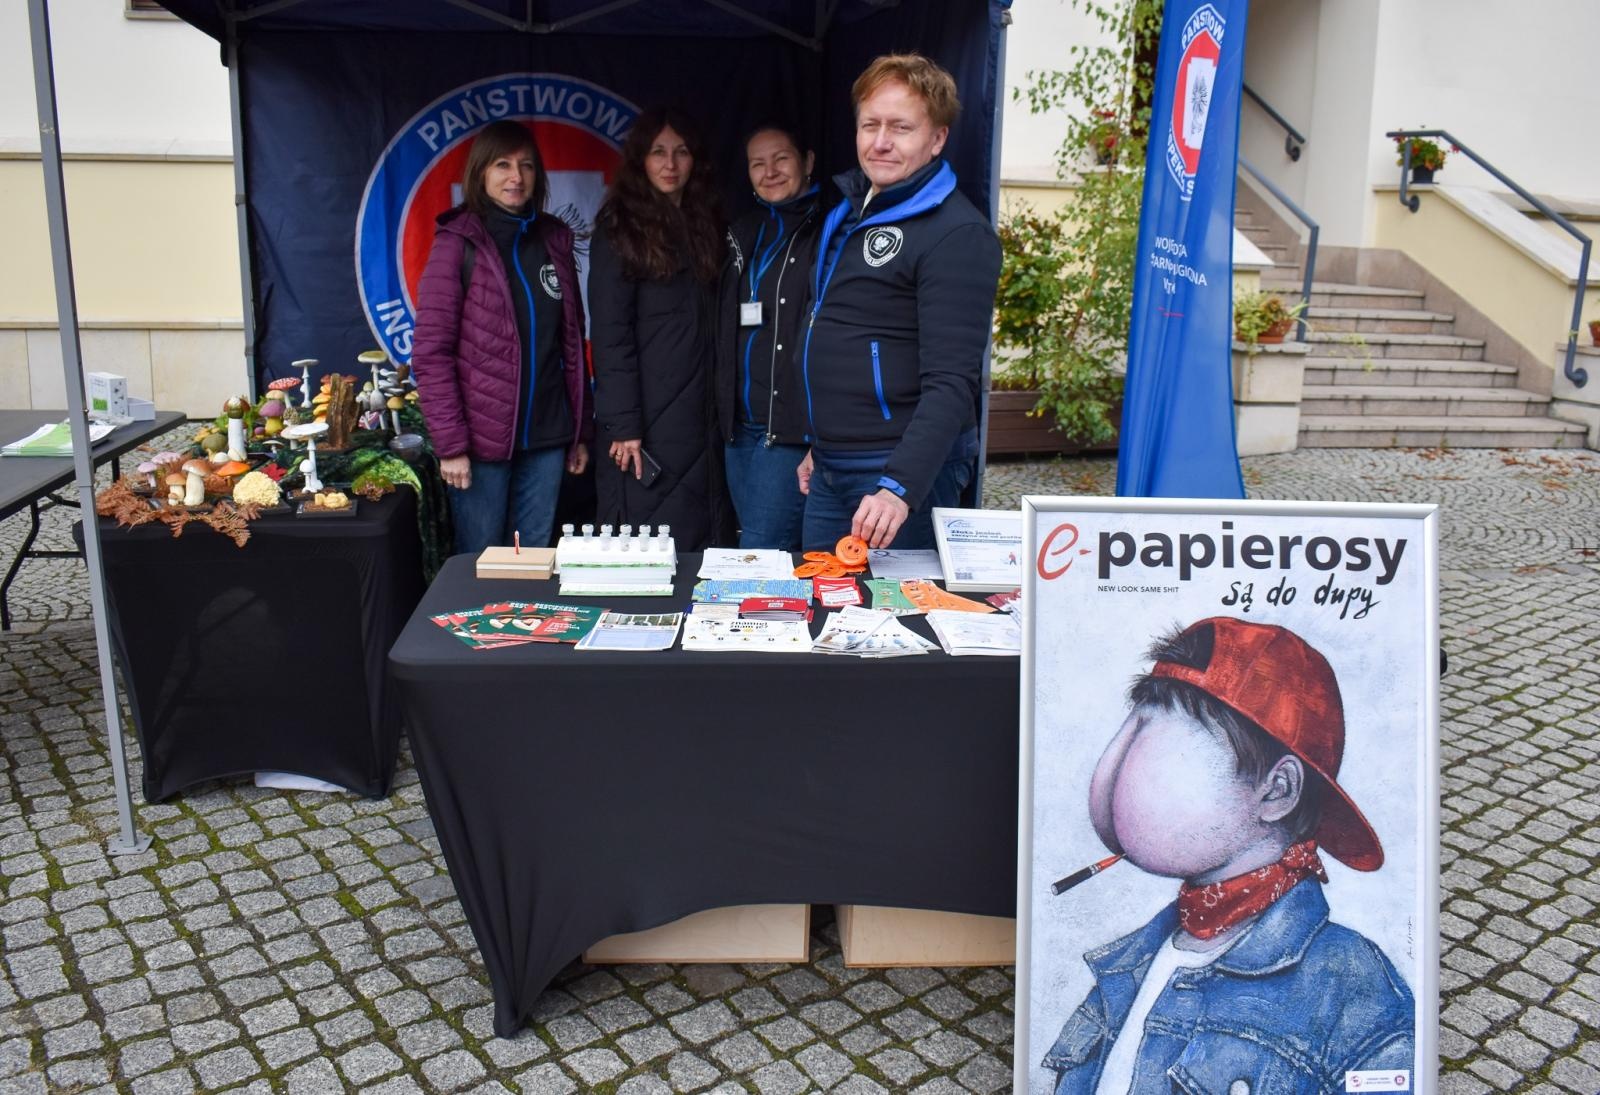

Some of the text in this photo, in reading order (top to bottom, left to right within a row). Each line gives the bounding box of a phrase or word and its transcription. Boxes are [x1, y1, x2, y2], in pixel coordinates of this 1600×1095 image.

[376, 299, 414, 364] INS
[1118, 585, 1139, 593] LOOK
[1266, 576, 1297, 606] do
[1314, 573, 1380, 620] dupy
